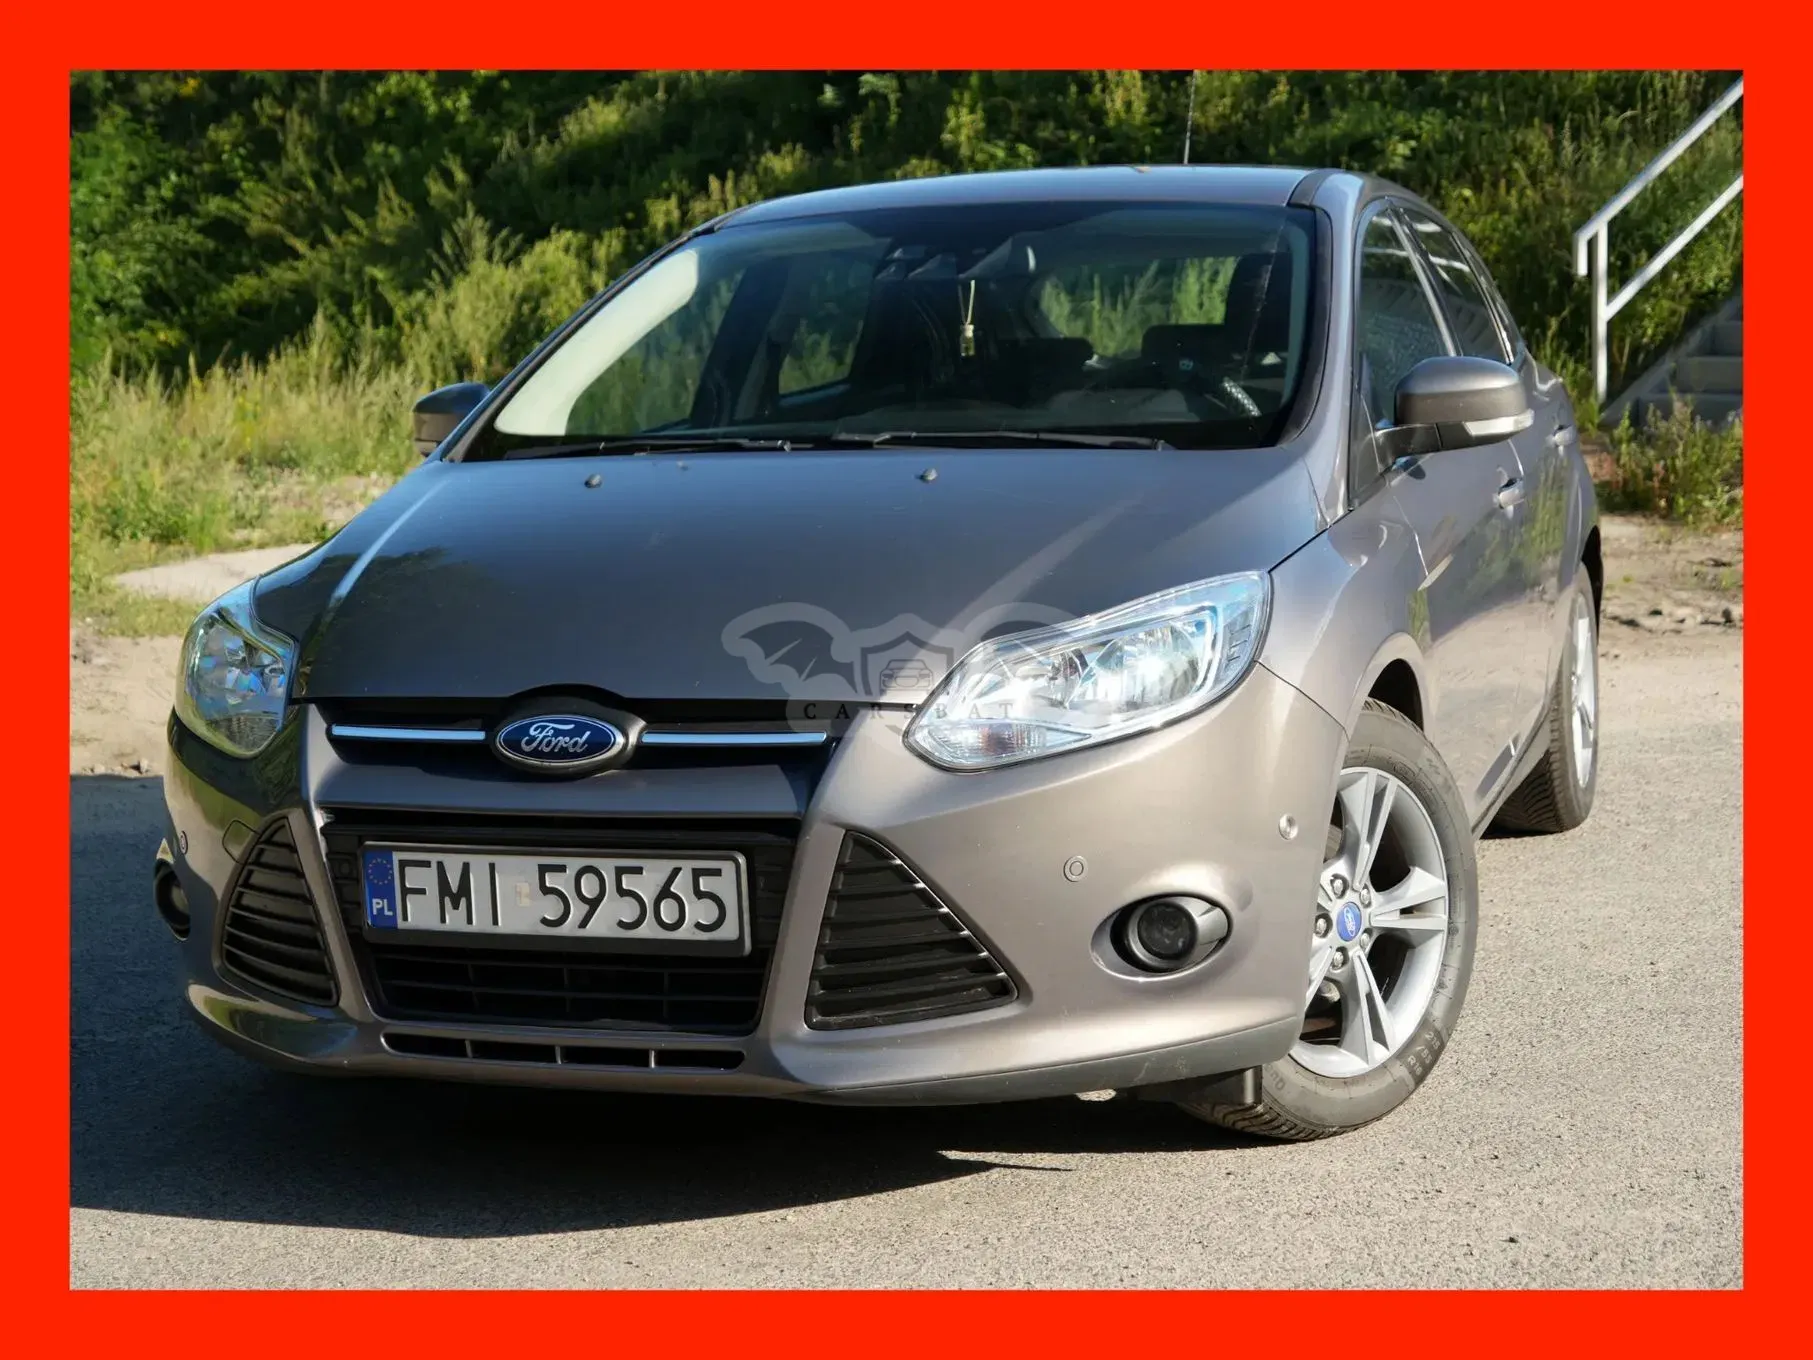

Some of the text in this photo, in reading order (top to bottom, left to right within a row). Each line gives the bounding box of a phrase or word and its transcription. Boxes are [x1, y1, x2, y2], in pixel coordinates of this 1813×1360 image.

[520, 722, 591, 753] Ford
[372, 898, 394, 916] PL
[398, 859, 727, 933] FMI 59565
